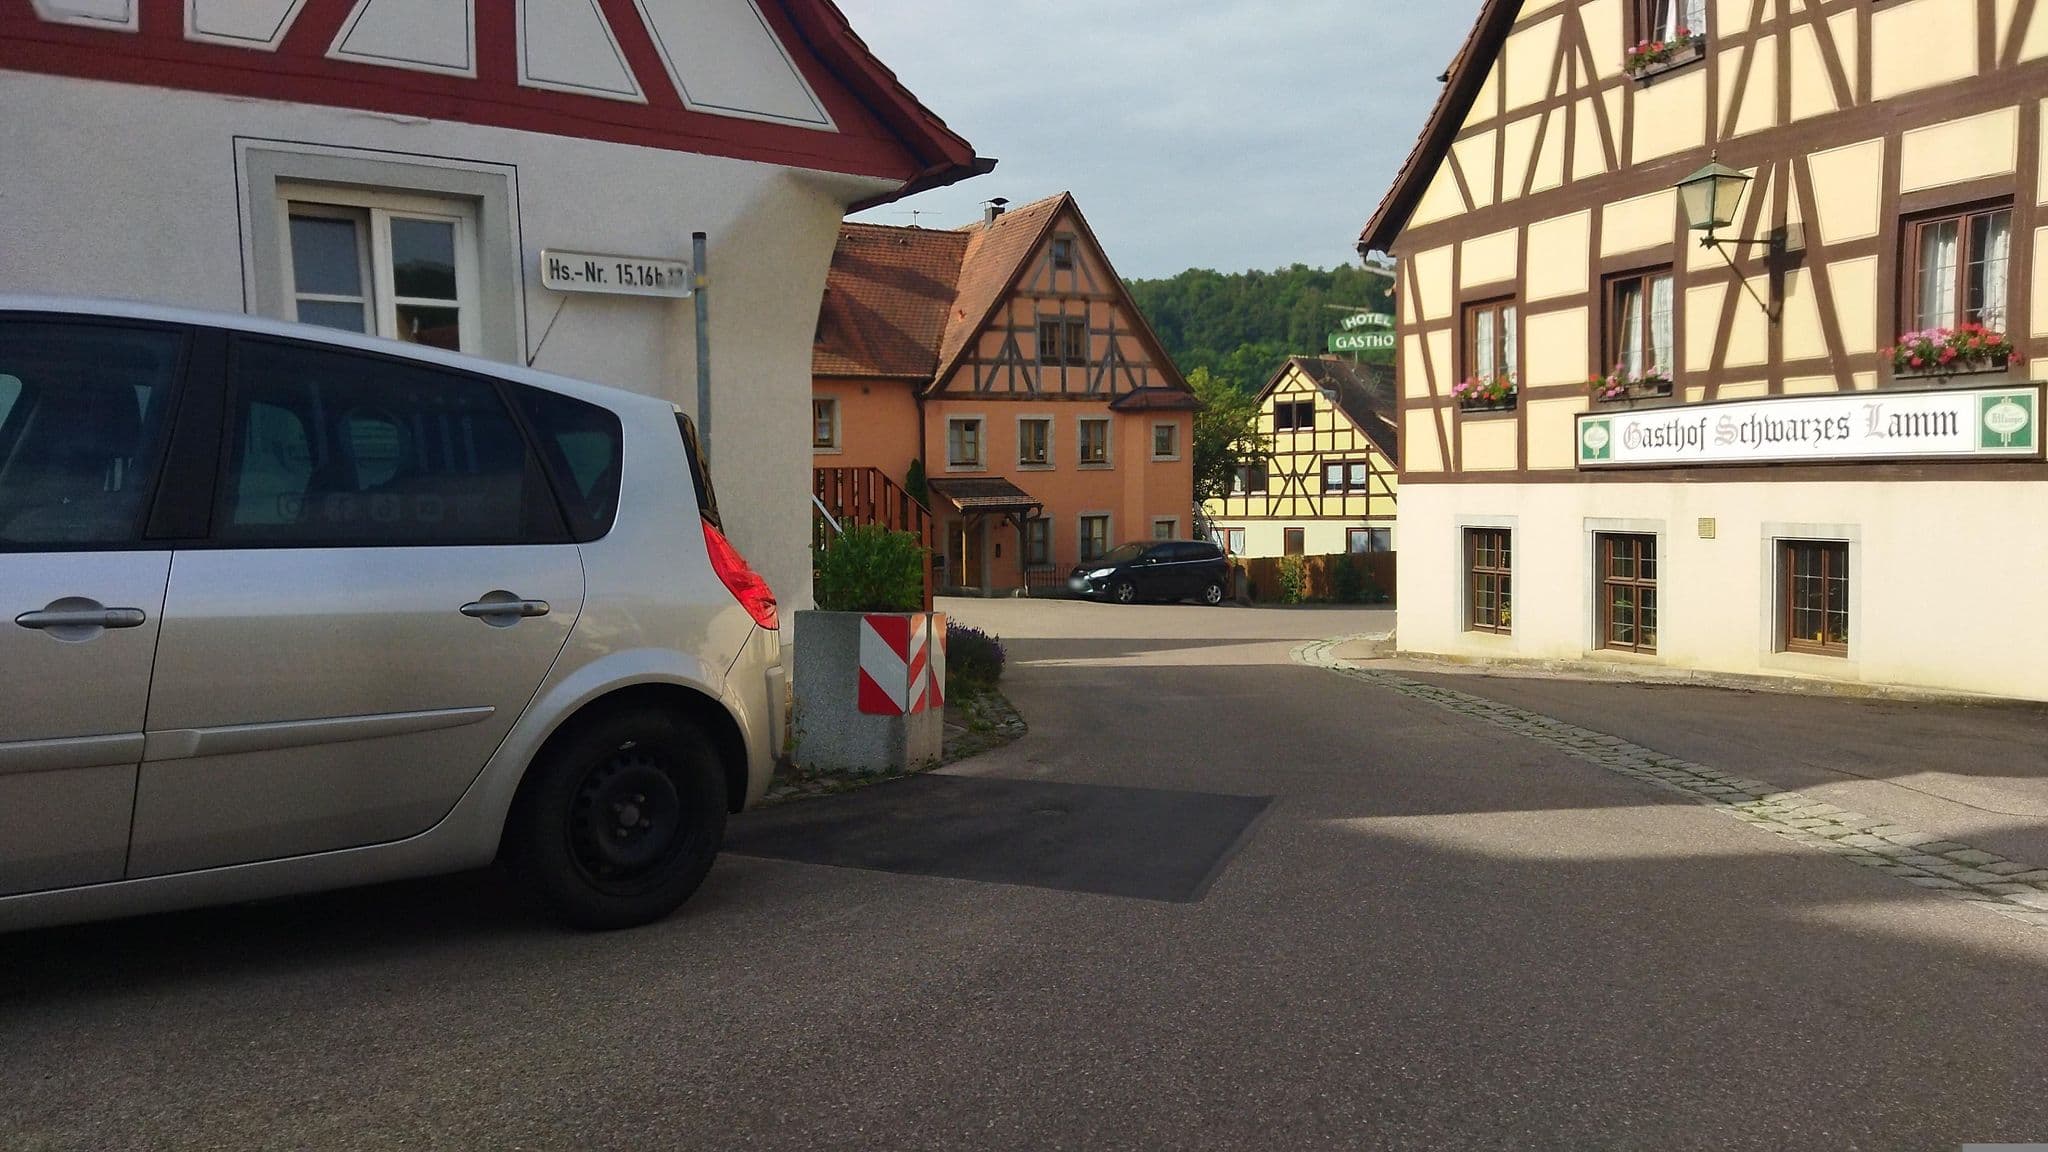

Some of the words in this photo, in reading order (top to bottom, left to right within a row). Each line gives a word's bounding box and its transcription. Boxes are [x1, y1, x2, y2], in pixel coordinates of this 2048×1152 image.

[549, 258, 607, 284] Hs.-Nr.
[1345, 312, 1392, 328] HOTEL
[1623, 417, 1707, 452] Gasthof
[1714, 412, 1851, 449] Schwarzes
[1863, 403, 1959, 438] Lamm
